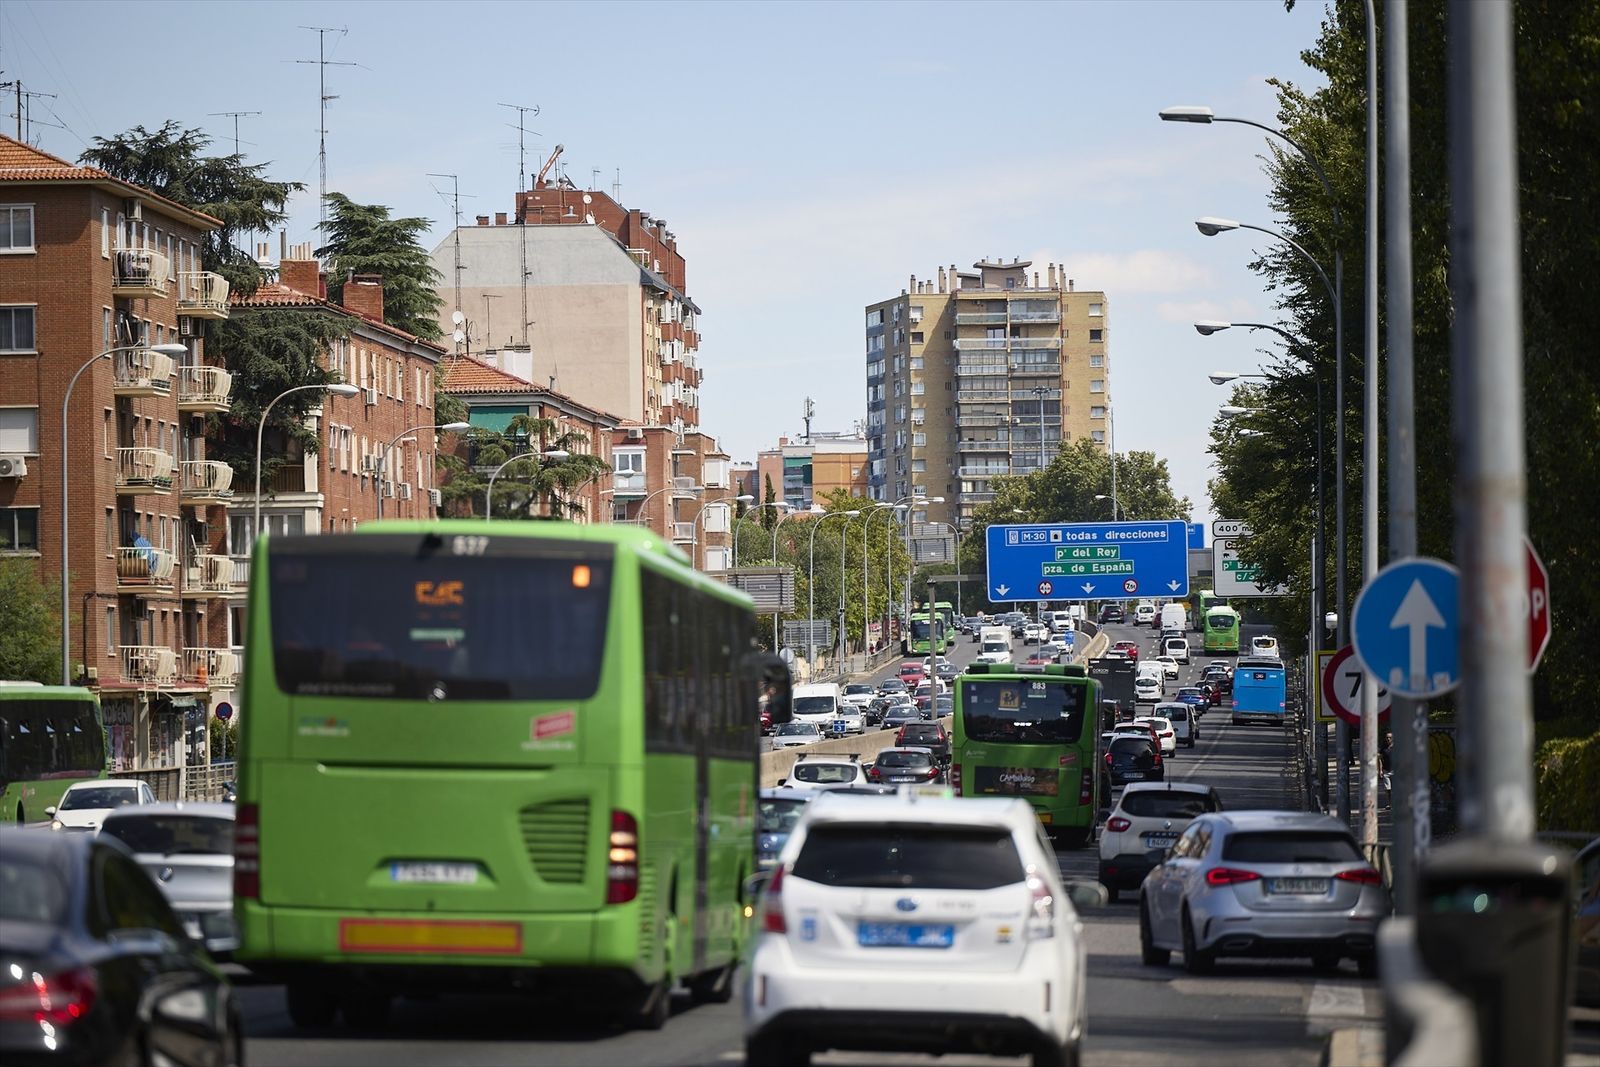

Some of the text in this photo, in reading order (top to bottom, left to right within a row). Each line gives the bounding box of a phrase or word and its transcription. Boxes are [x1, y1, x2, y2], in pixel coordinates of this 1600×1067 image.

[1066, 529, 1166, 540] todas direcciones
[1072, 548, 1090, 557] del
[1097, 547, 1117, 557] Rey
[1044, 562, 1132, 574] pza. de España
